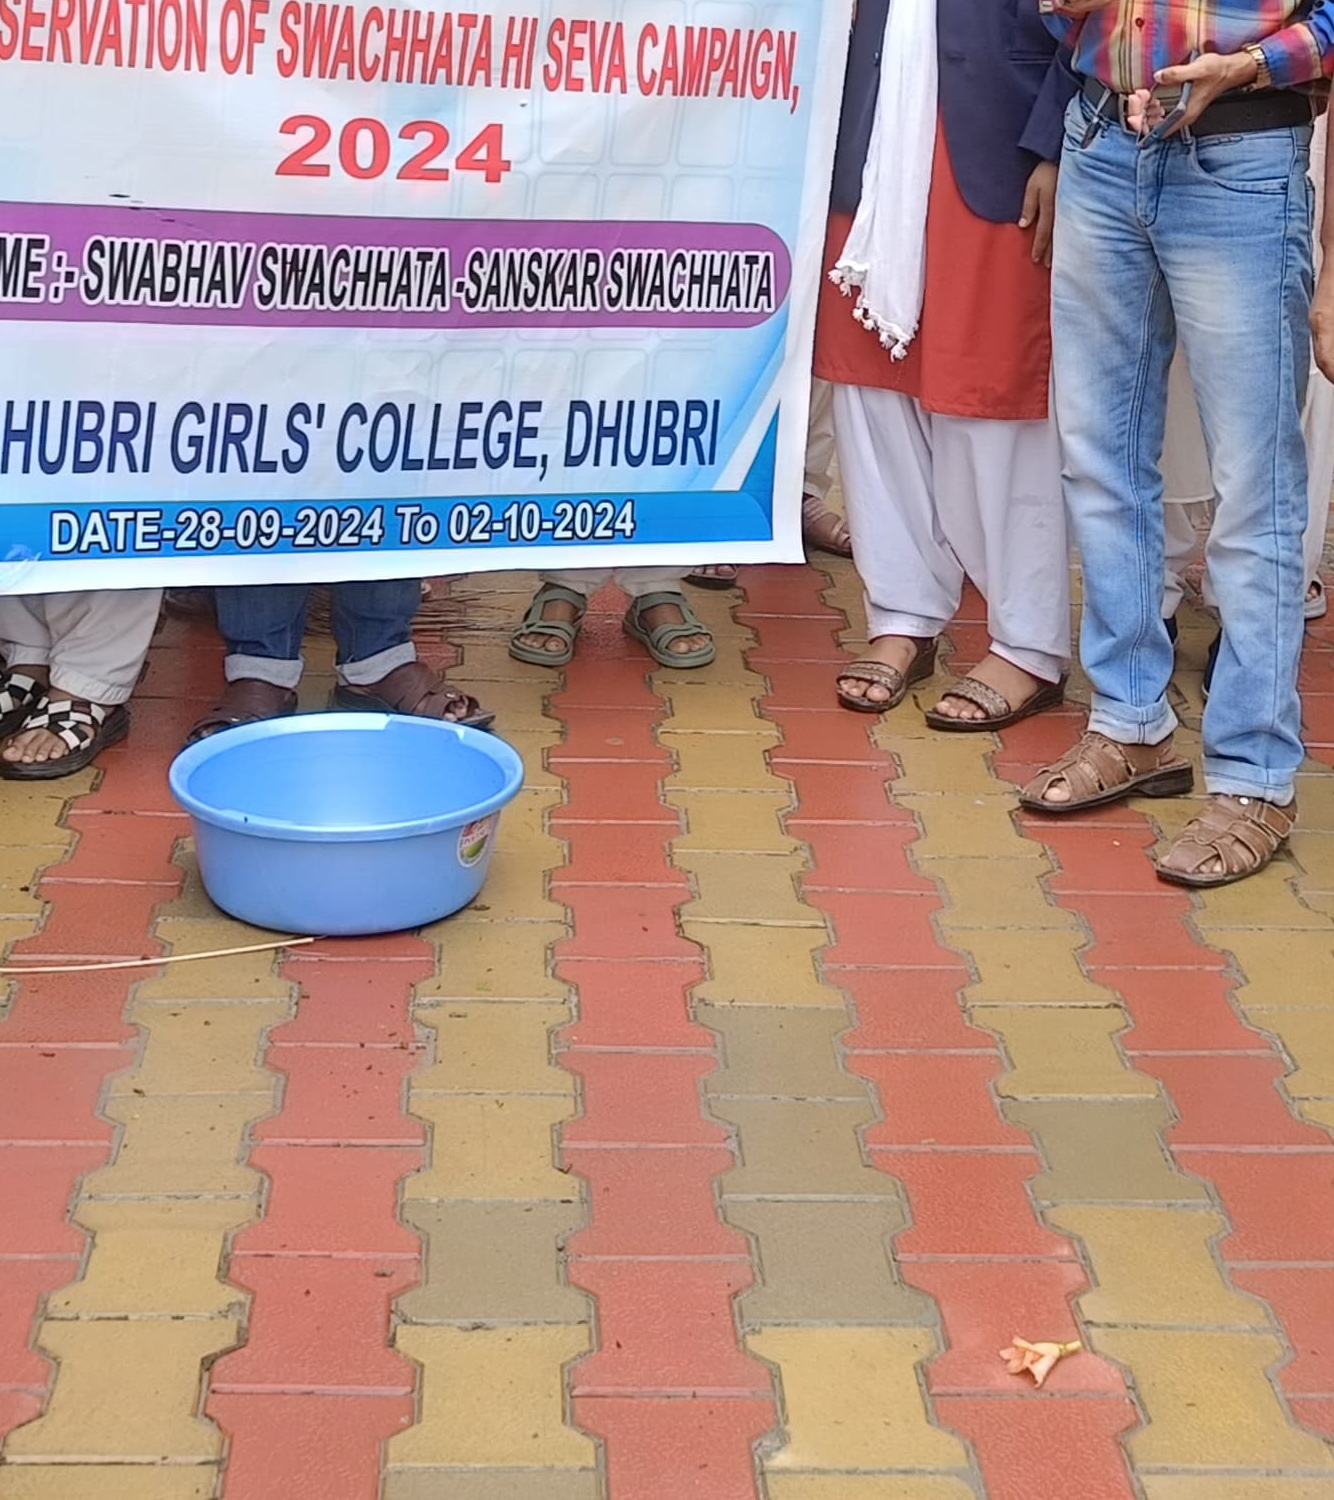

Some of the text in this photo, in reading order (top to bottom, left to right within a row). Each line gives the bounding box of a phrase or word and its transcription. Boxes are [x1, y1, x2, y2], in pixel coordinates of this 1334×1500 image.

[276, 0, 492, 89] SWACHHATA
[500, 15, 539, 90] HI
[543, 17, 628, 95] SEVA
[637, 21, 801, 114] CAMPAIGN,
[275, 114, 511, 184] 2024
[83, 239, 253, 307] SWABHAV
[257, 246, 447, 308] SWACHHATA
[607, 250, 773, 310] SWACHHATA
[170, 400, 325, 474] GIRLS'
[336, 398, 549, 482] COLLEGE,
[563, 398, 721, 467] DHUBRI
[396, 506, 438, 543] To
[448, 499, 635, 542] 02-10-2024
